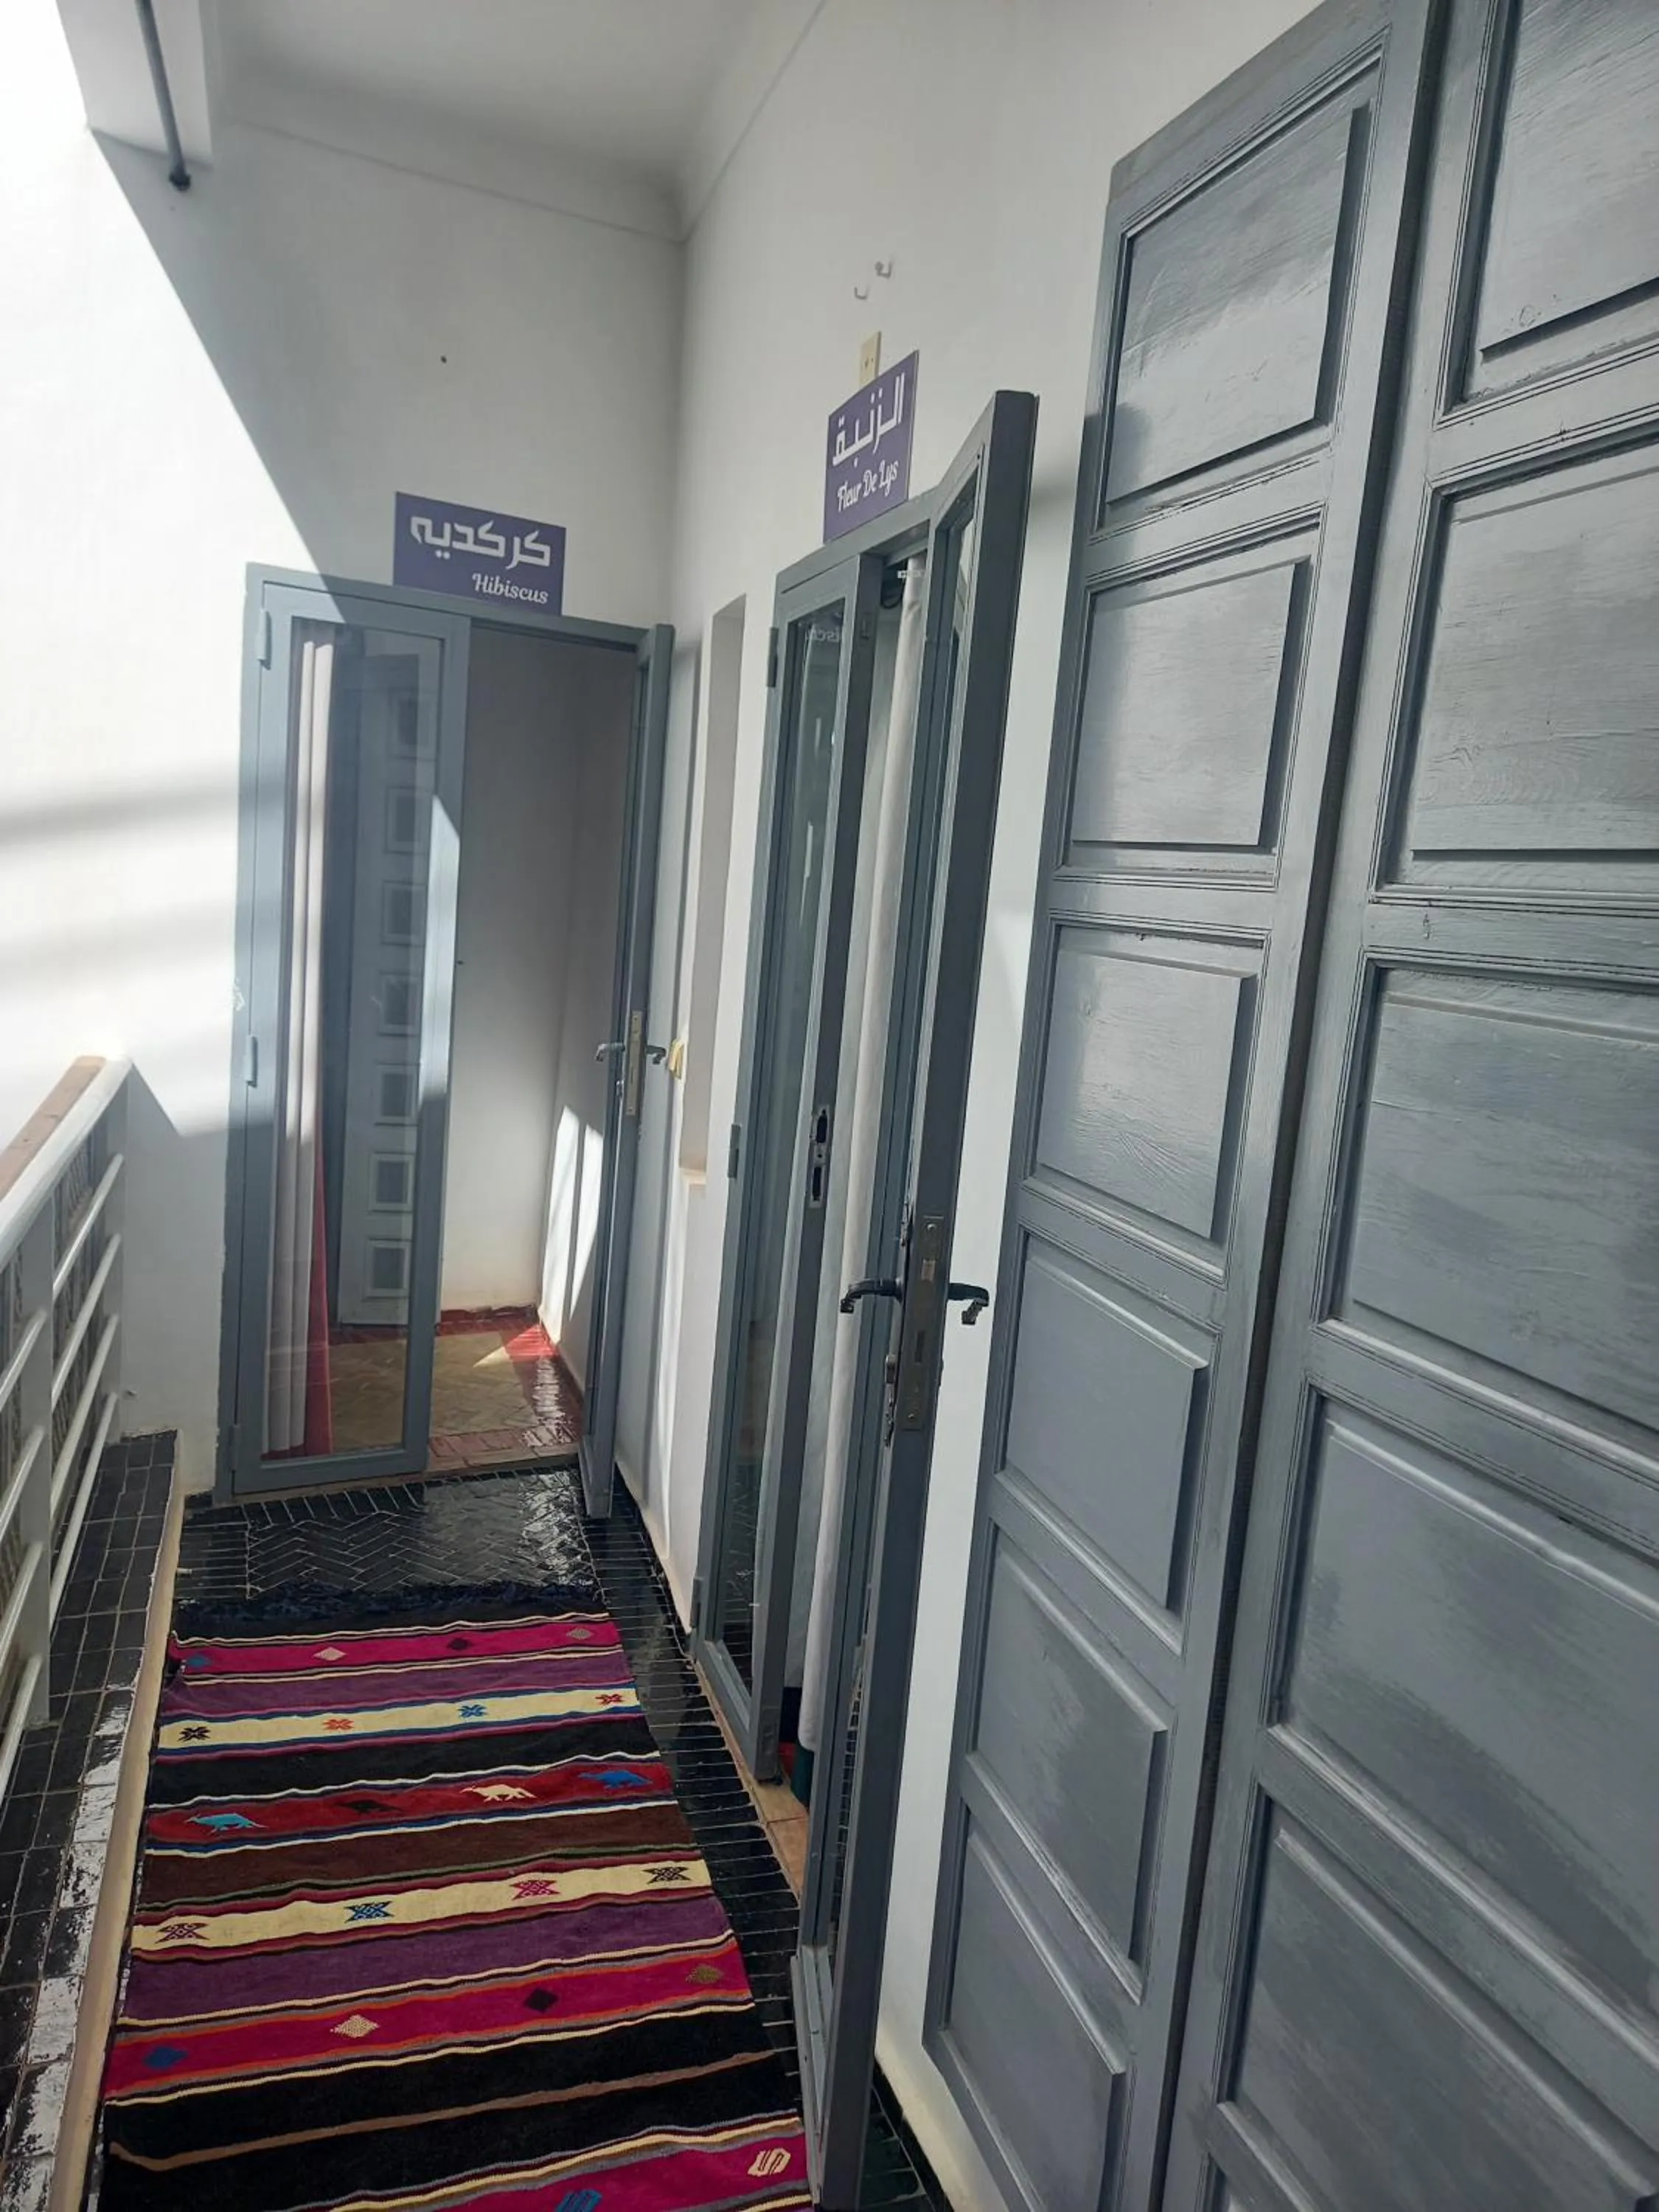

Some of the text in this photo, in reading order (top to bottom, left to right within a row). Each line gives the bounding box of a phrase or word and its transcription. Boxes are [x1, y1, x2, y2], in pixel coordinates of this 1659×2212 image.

[837, 459, 899, 512] Fleur De Lys
[410, 515, 552, 570] كركديه
[472, 572, 549, 605] Hibiscus
